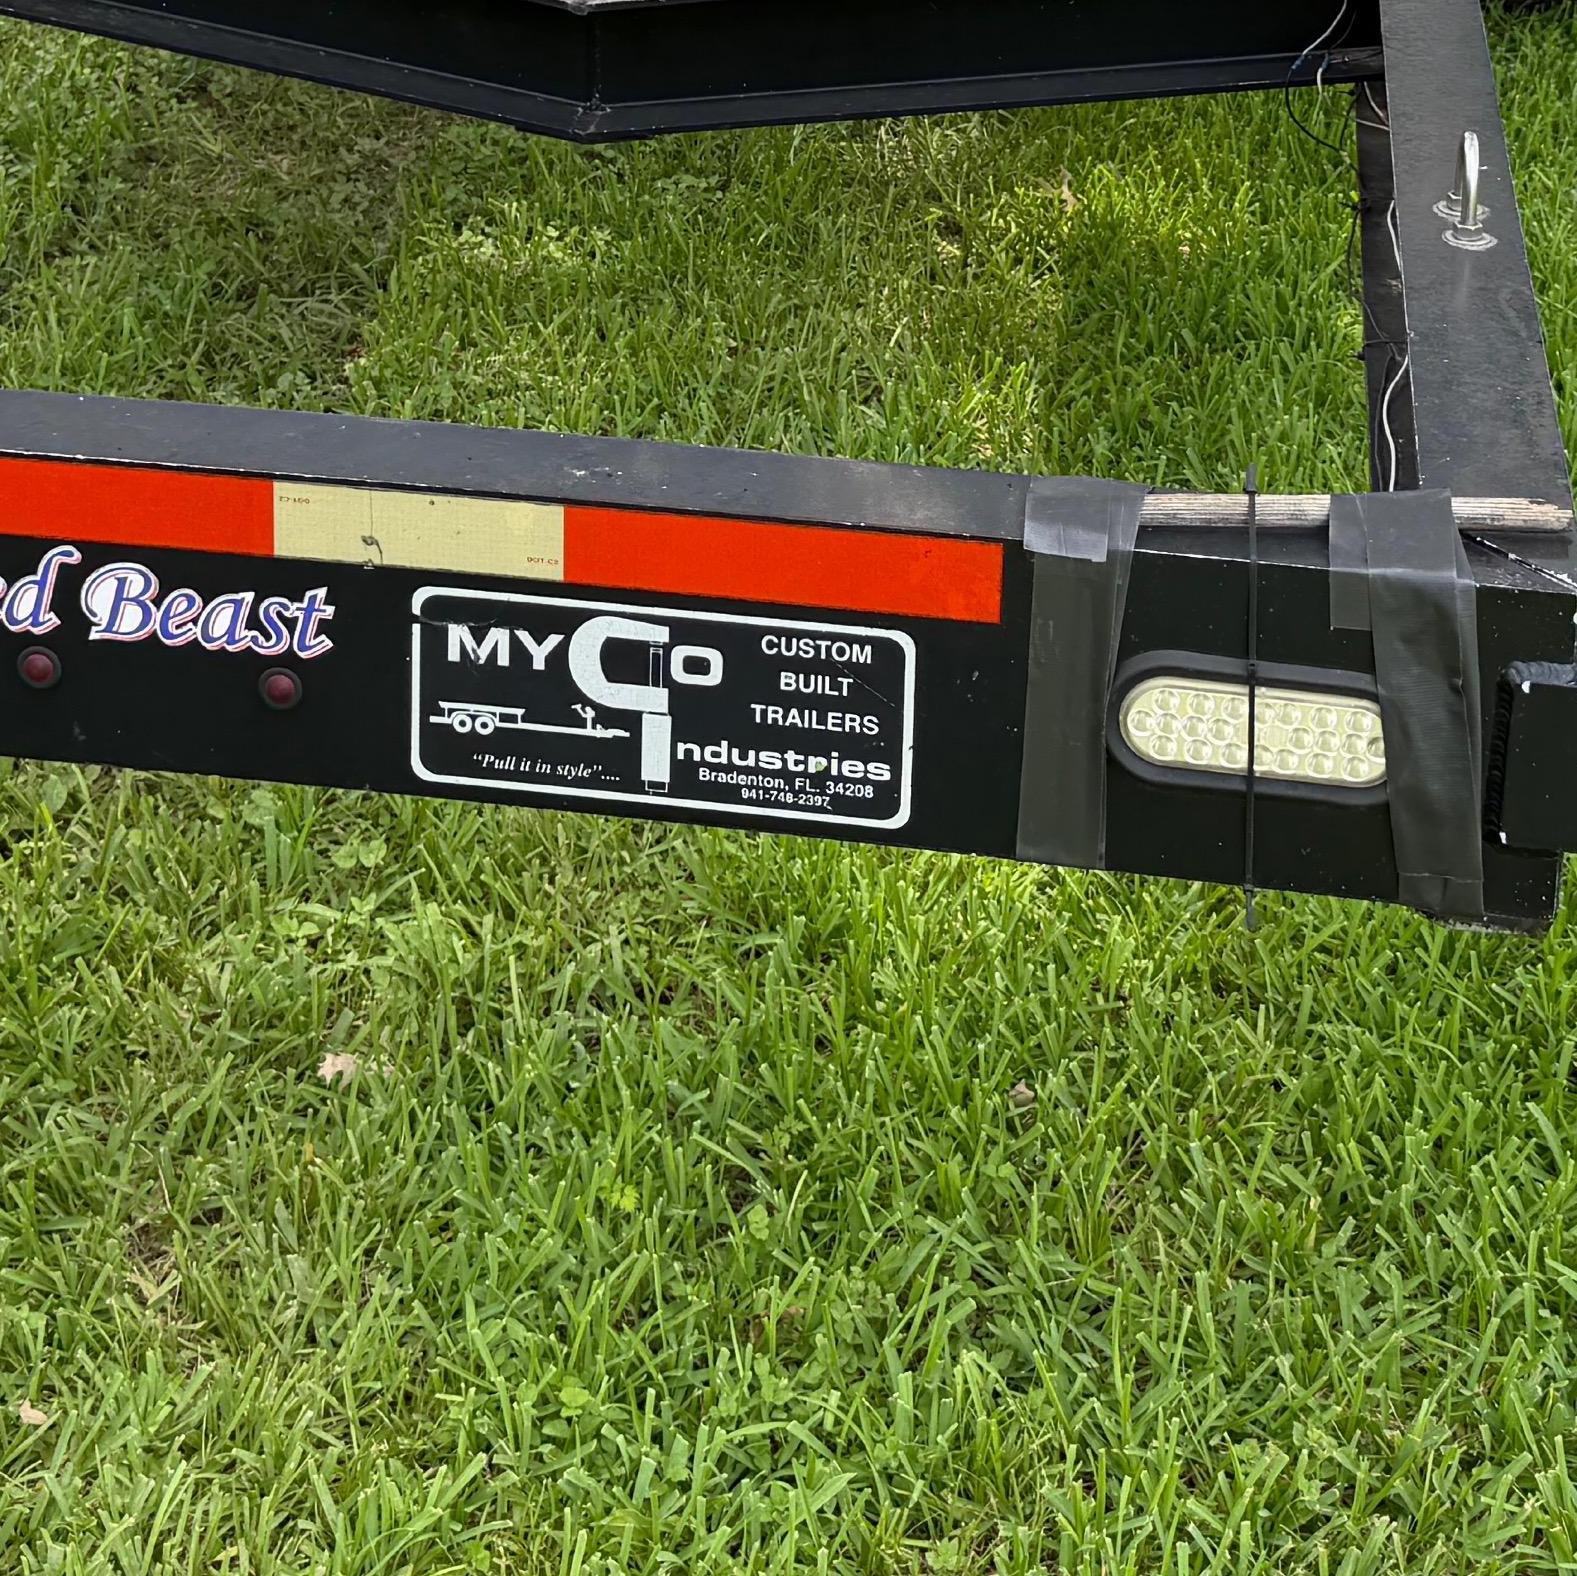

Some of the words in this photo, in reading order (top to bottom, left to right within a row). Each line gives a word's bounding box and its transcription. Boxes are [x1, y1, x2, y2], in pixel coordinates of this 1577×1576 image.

[81, 561, 336, 660] Beast
[761, 634, 872, 664] CUSTOM
[780, 671, 853, 697] BUILT
[750, 703, 880, 736] TRAILERS
[520, 757, 531, 772] it
[536, 759, 551, 774] in
[698, 767, 789, 791] Bradenton,
[825, 781, 874, 799] 34208
